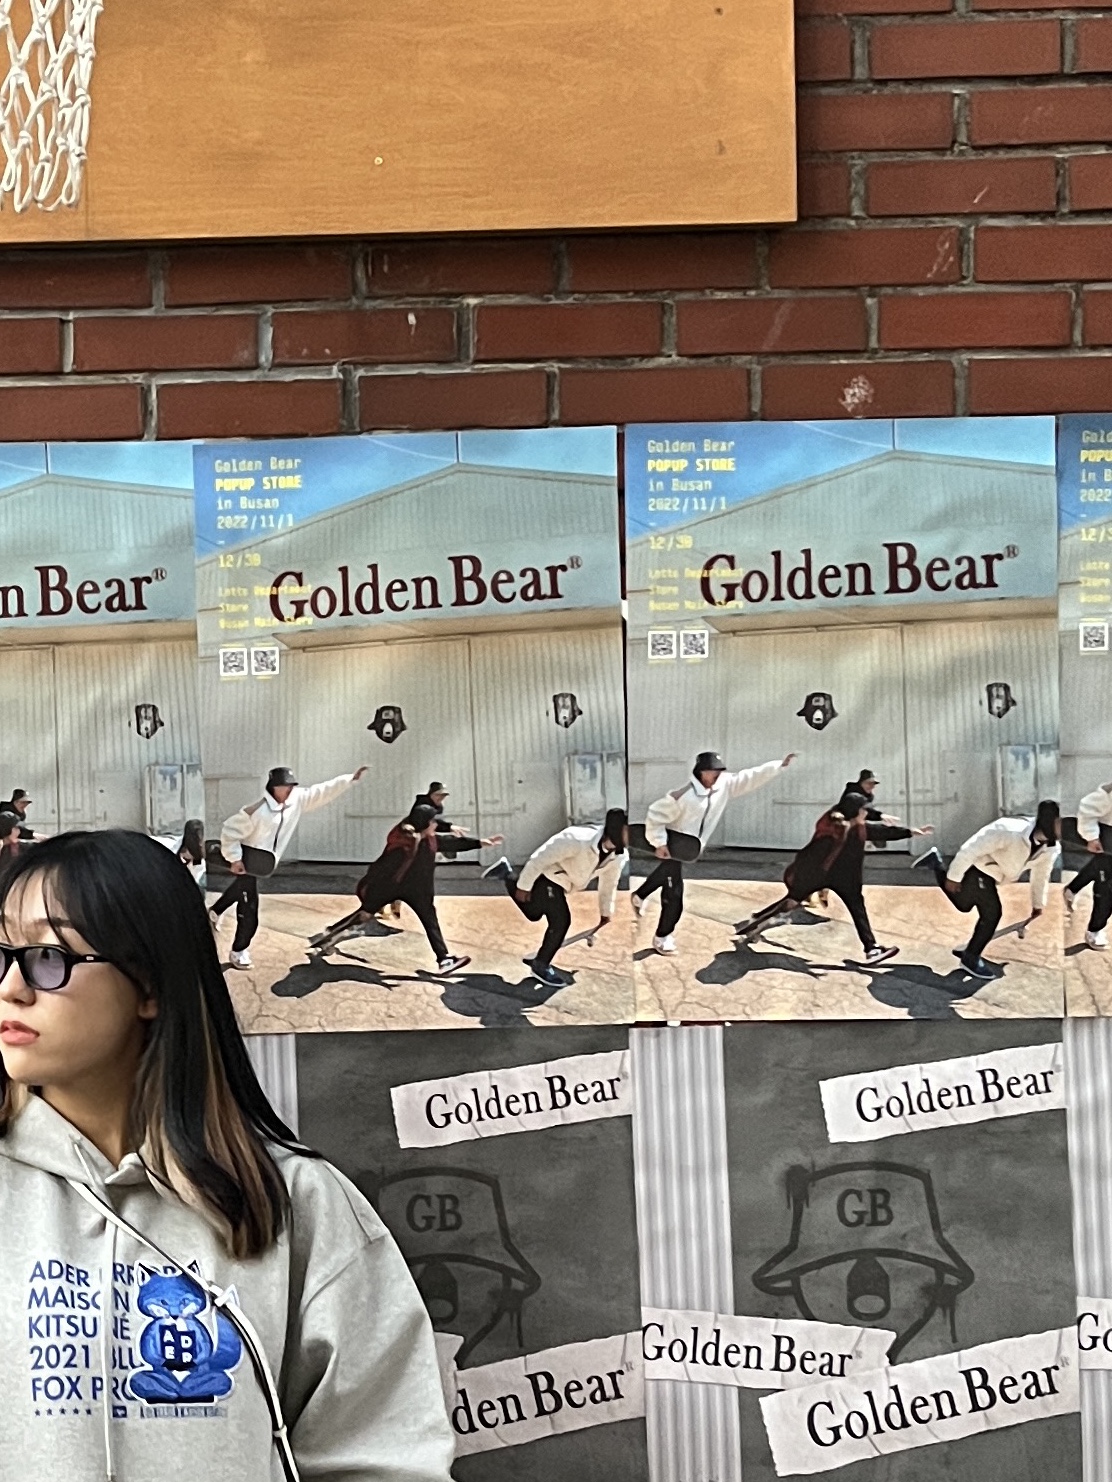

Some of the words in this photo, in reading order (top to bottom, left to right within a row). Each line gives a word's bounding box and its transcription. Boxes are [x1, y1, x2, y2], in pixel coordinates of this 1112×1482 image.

[648, 439, 696, 453] Golden
[703, 438, 735, 453] Bear
[214, 458, 263, 473] Golden
[270, 456, 301, 470] Bear
[647, 458, 689, 472] POPUP
[695, 457, 736, 472] STORE
[1081, 468, 1096, 483] in
[215, 477, 255, 492] POPUP
[262, 475, 303, 490] STORE
[649, 478, 664, 492] in
[671, 477, 713, 492] Busan
[217, 496, 232, 510] in
[240, 496, 280, 510] Busan
[648, 496, 727, 513] 2022/11/1
[216, 513, 294, 530] 2022/11/1
[649, 534, 693, 551] 12/30
[218, 553, 261, 568] 12/30
[700, 549, 875, 606] Golden
[270, 564, 442, 623] Golden
[425, 1085, 543, 1129] Golden
[856, 1079, 975, 1123] Golden
[405, 1192, 463, 1234] GB
[837, 1188, 894, 1228] GB
[29, 1259, 90, 1288] ADER
[29, 1343, 90, 1370] 2021
[641, 1322, 764, 1371] Golden
[31, 1375, 83, 1402] FOX
[807, 1385, 962, 1447] Golden
